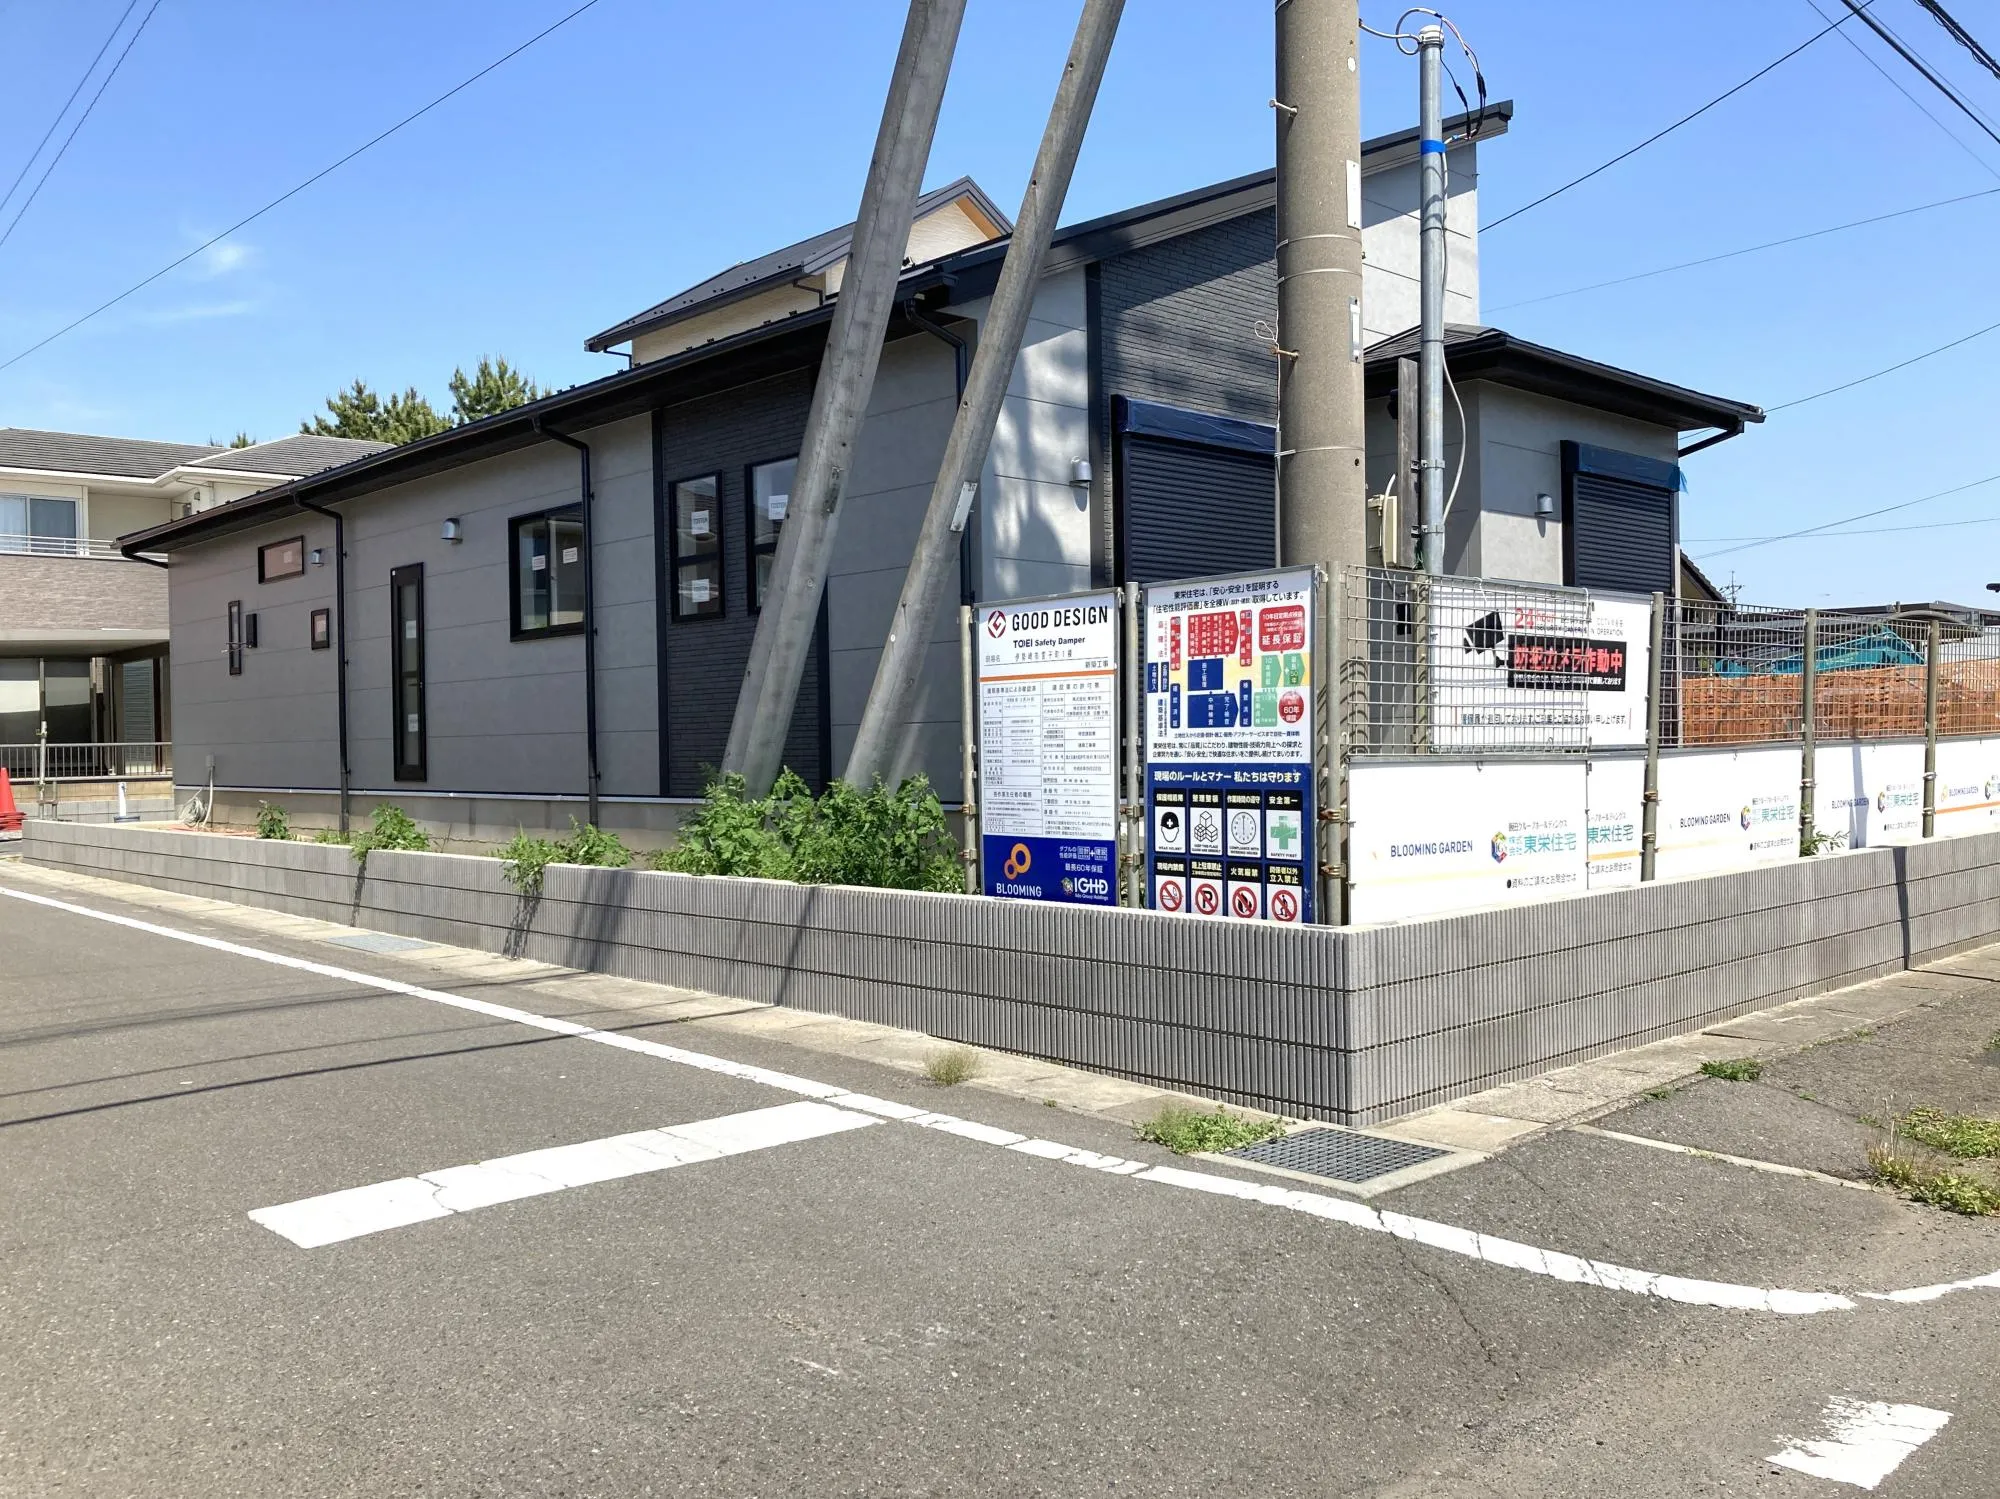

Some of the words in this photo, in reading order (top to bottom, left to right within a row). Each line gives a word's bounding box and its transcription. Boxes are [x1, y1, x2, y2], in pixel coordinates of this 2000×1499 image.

[1012, 611, 1049, 632] GOOD
[1054, 606, 1108, 628] DESIGN
[1515, 608, 1534, 628] 24
[1262, 632, 1303, 646] 延長保証
[1597, 628, 1623, 636] OPERATION
[1013, 639, 1033, 648] TOEI
[1034, 638, 1056, 648] Safety
[1058, 636, 1086, 646] Damper
[1514, 645, 1622, 674] 防犯カメラ作動中
[1154, 770, 1232, 782] 現場のルールとマナー
[1234, 771, 1301, 783] 私たちは守ります
[1192, 794, 1219, 802] 整理整頓
[1269, 796, 1298, 804] 安全第一
[1832, 798, 1852, 809] BLOOMING
[1854, 797, 1869, 806] GARDEN
[1680, 816, 1708, 828] BLOOMING
[1709, 813, 1731, 824] GARDEN
[1762, 805, 1794, 823] 東栄住宅
[1588, 824, 1634, 845] 東栄住宅
[1390, 842, 1437, 858] BLOOMING
[1439, 840, 1473, 854] GARDEN
[1524, 832, 1576, 854] 東栄住宅
[1065, 863, 1103, 874] 最長60年保証
[1230, 867, 1258, 876] 火気厳禁
[1270, 866, 1298, 875] 関係者以外
[1074, 878, 1108, 894] IGHD
[1270, 875, 1298, 884] 立入禁止
[996, 882, 1042, 898] BLOOMING
